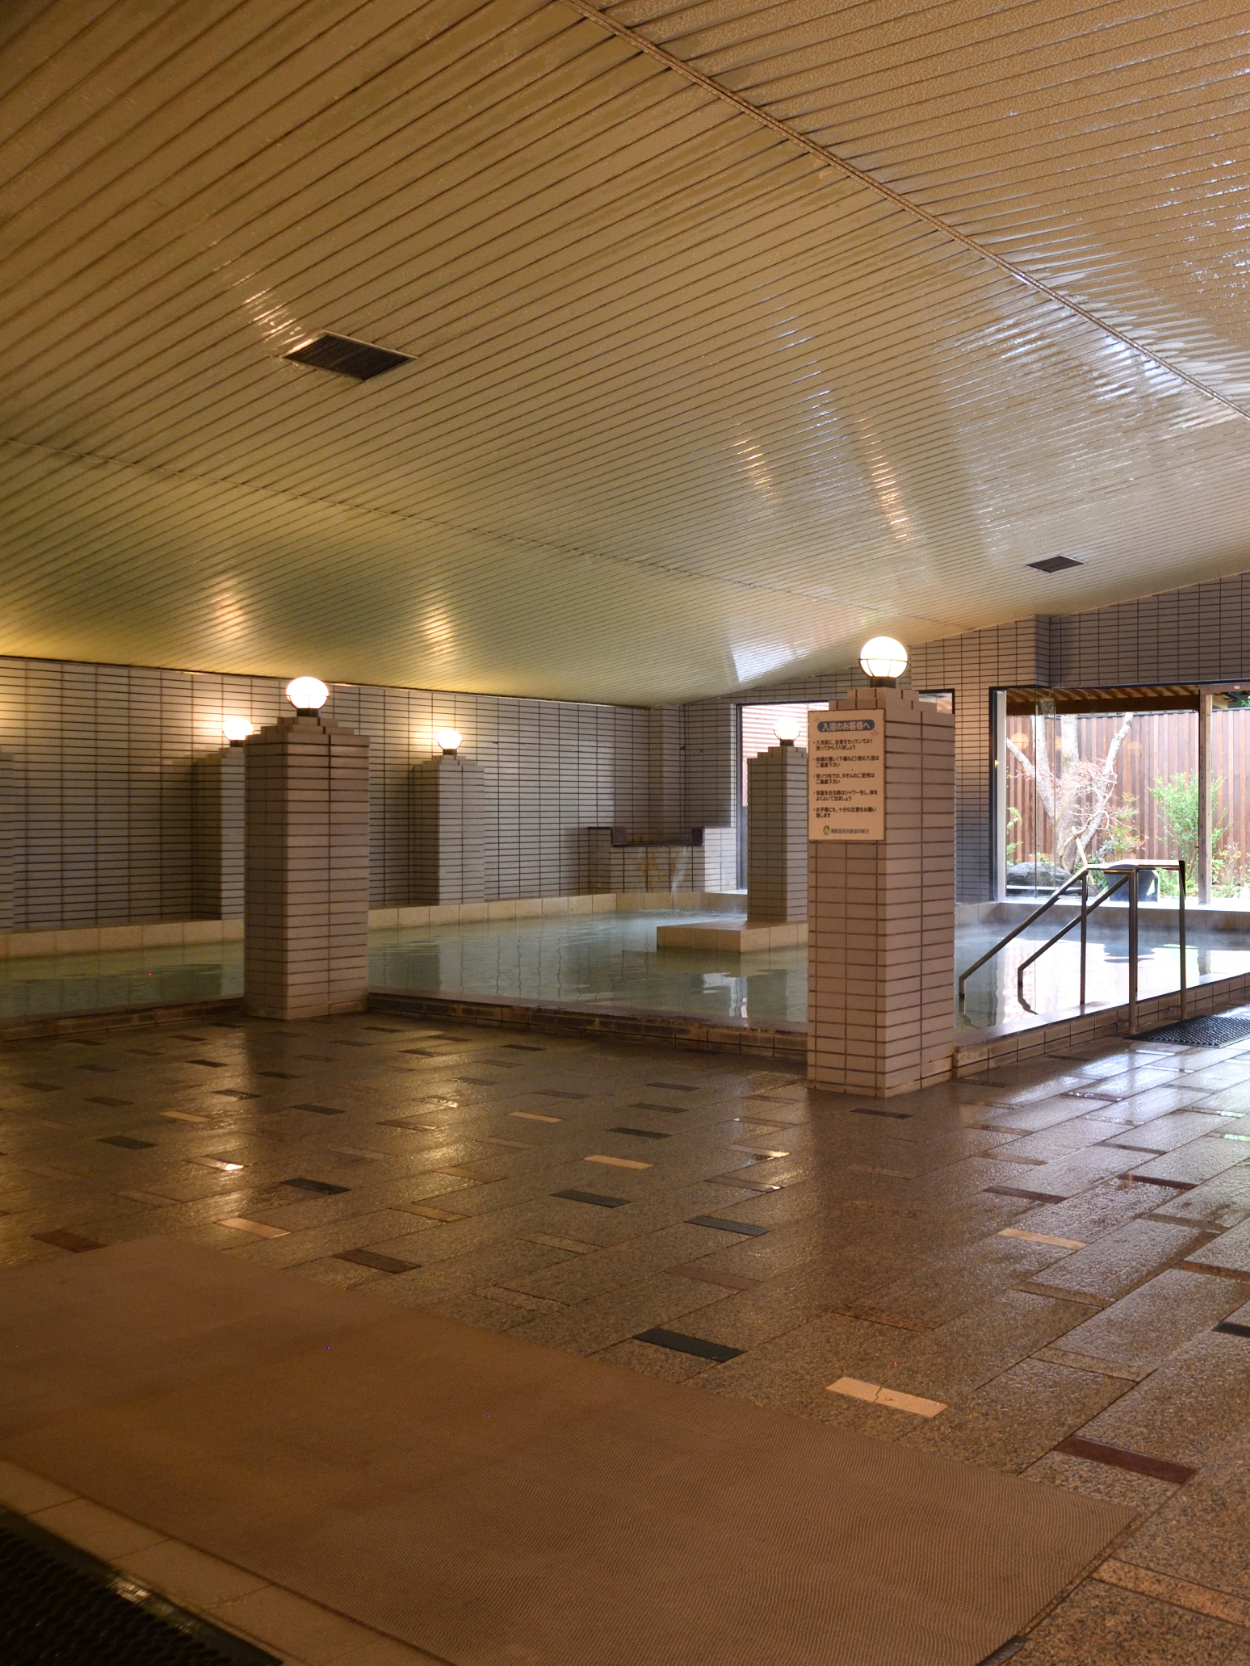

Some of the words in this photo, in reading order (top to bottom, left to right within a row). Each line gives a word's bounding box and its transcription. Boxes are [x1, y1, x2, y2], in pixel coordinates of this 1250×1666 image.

[822, 721, 870, 732] 入浴のお客様へ
